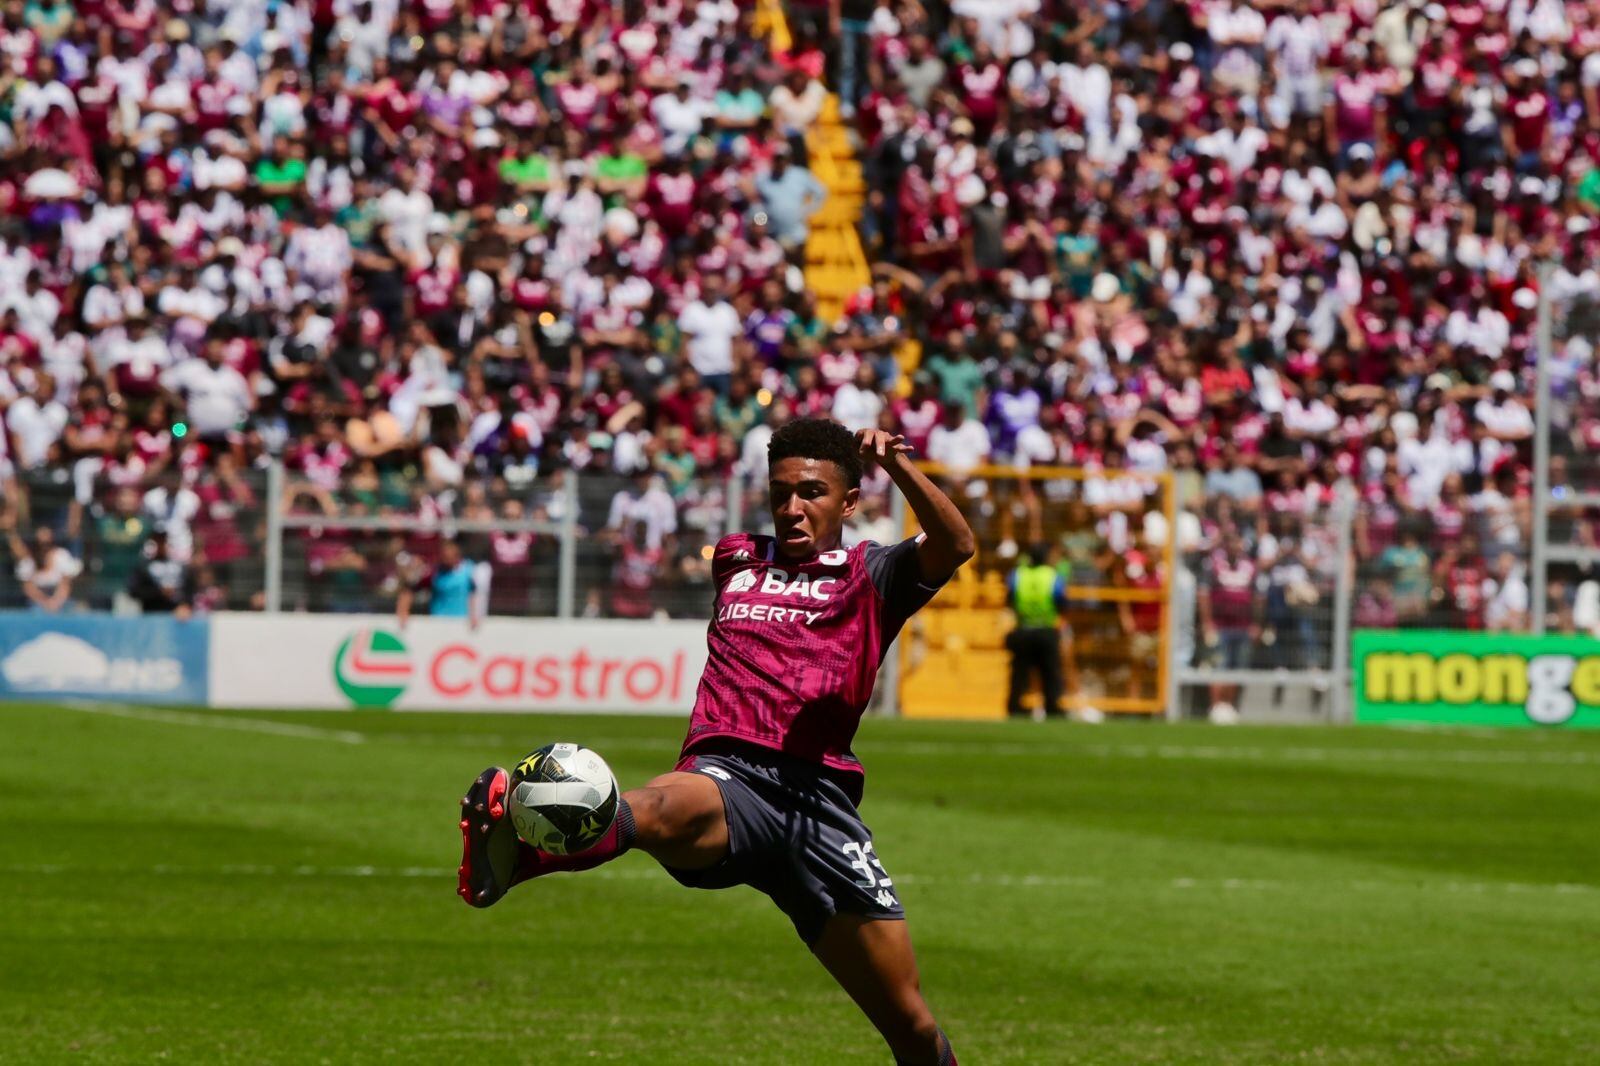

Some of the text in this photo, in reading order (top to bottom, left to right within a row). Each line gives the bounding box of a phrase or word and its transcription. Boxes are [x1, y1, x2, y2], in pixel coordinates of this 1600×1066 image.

[760, 567, 837, 601] BAC
[718, 603, 823, 626] LIBERTY
[428, 643, 685, 702] Castrol
